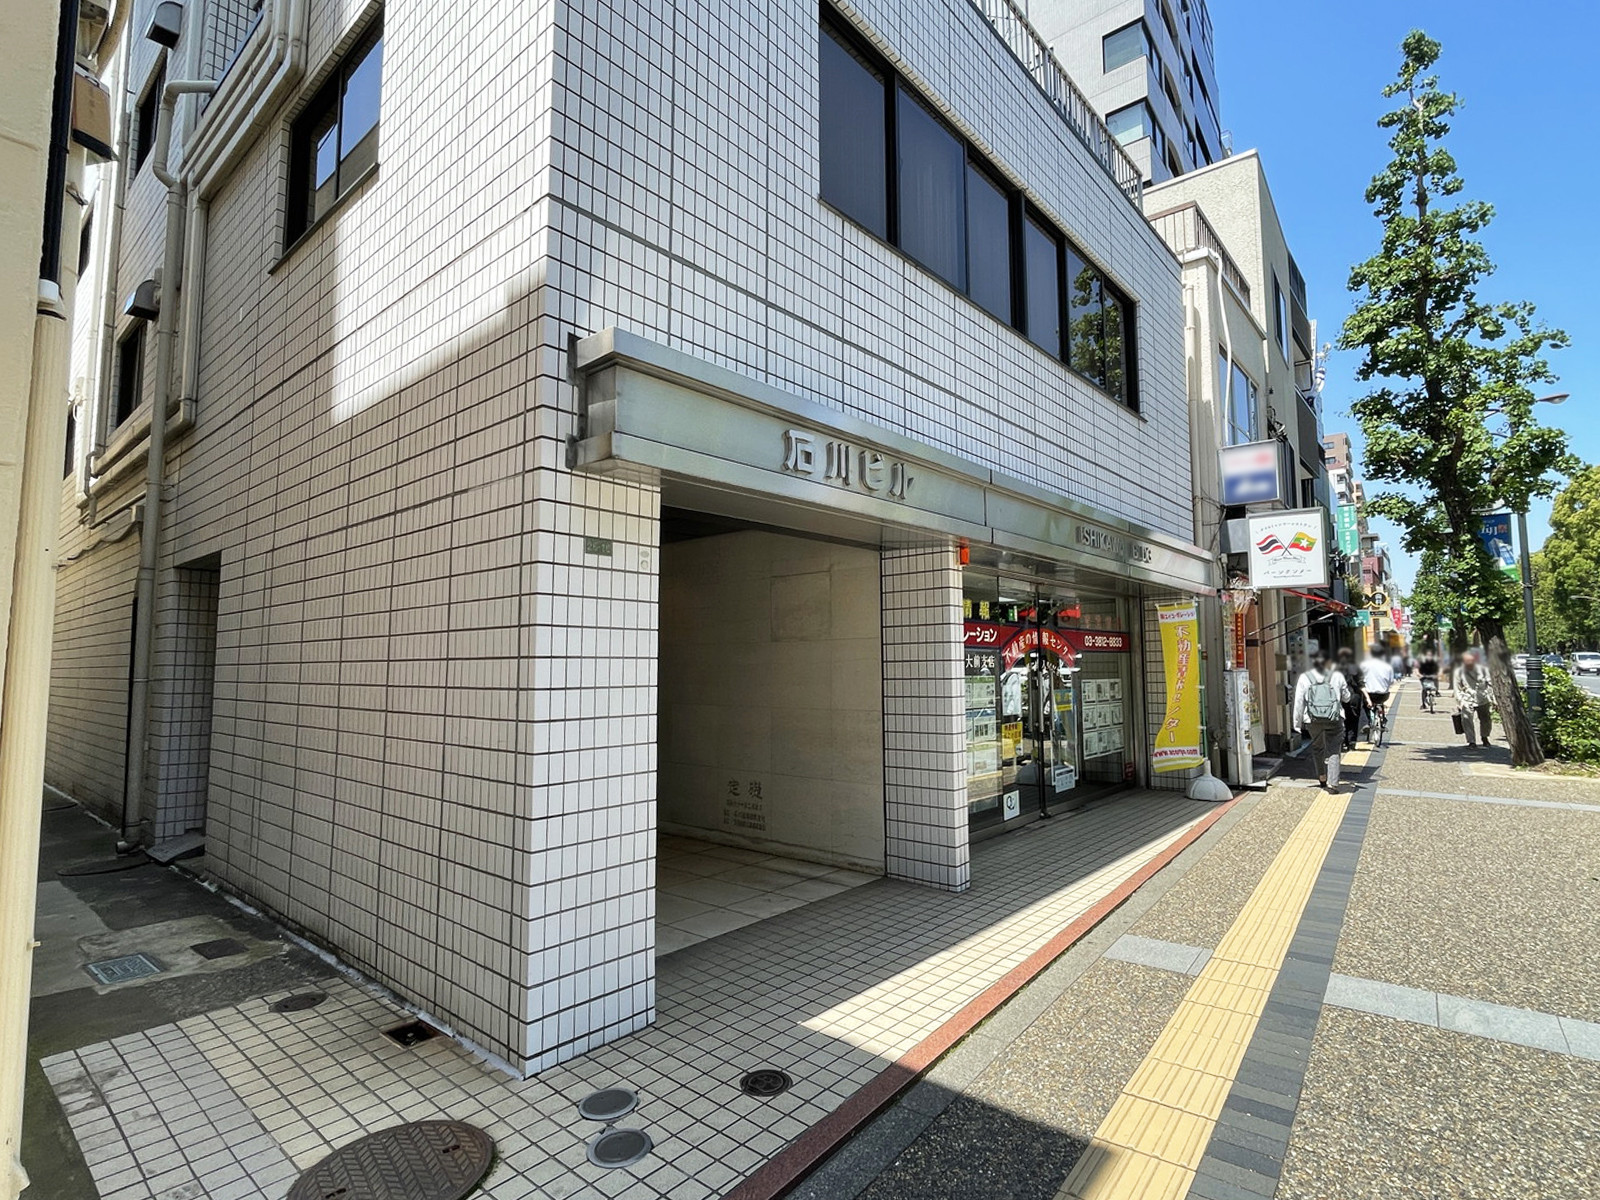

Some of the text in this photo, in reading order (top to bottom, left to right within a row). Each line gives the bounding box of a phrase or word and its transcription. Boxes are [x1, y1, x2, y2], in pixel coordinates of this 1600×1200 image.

[781, 429, 914, 500] 石川ビル
[1076, 526, 1125, 556] ISHIKAWA
